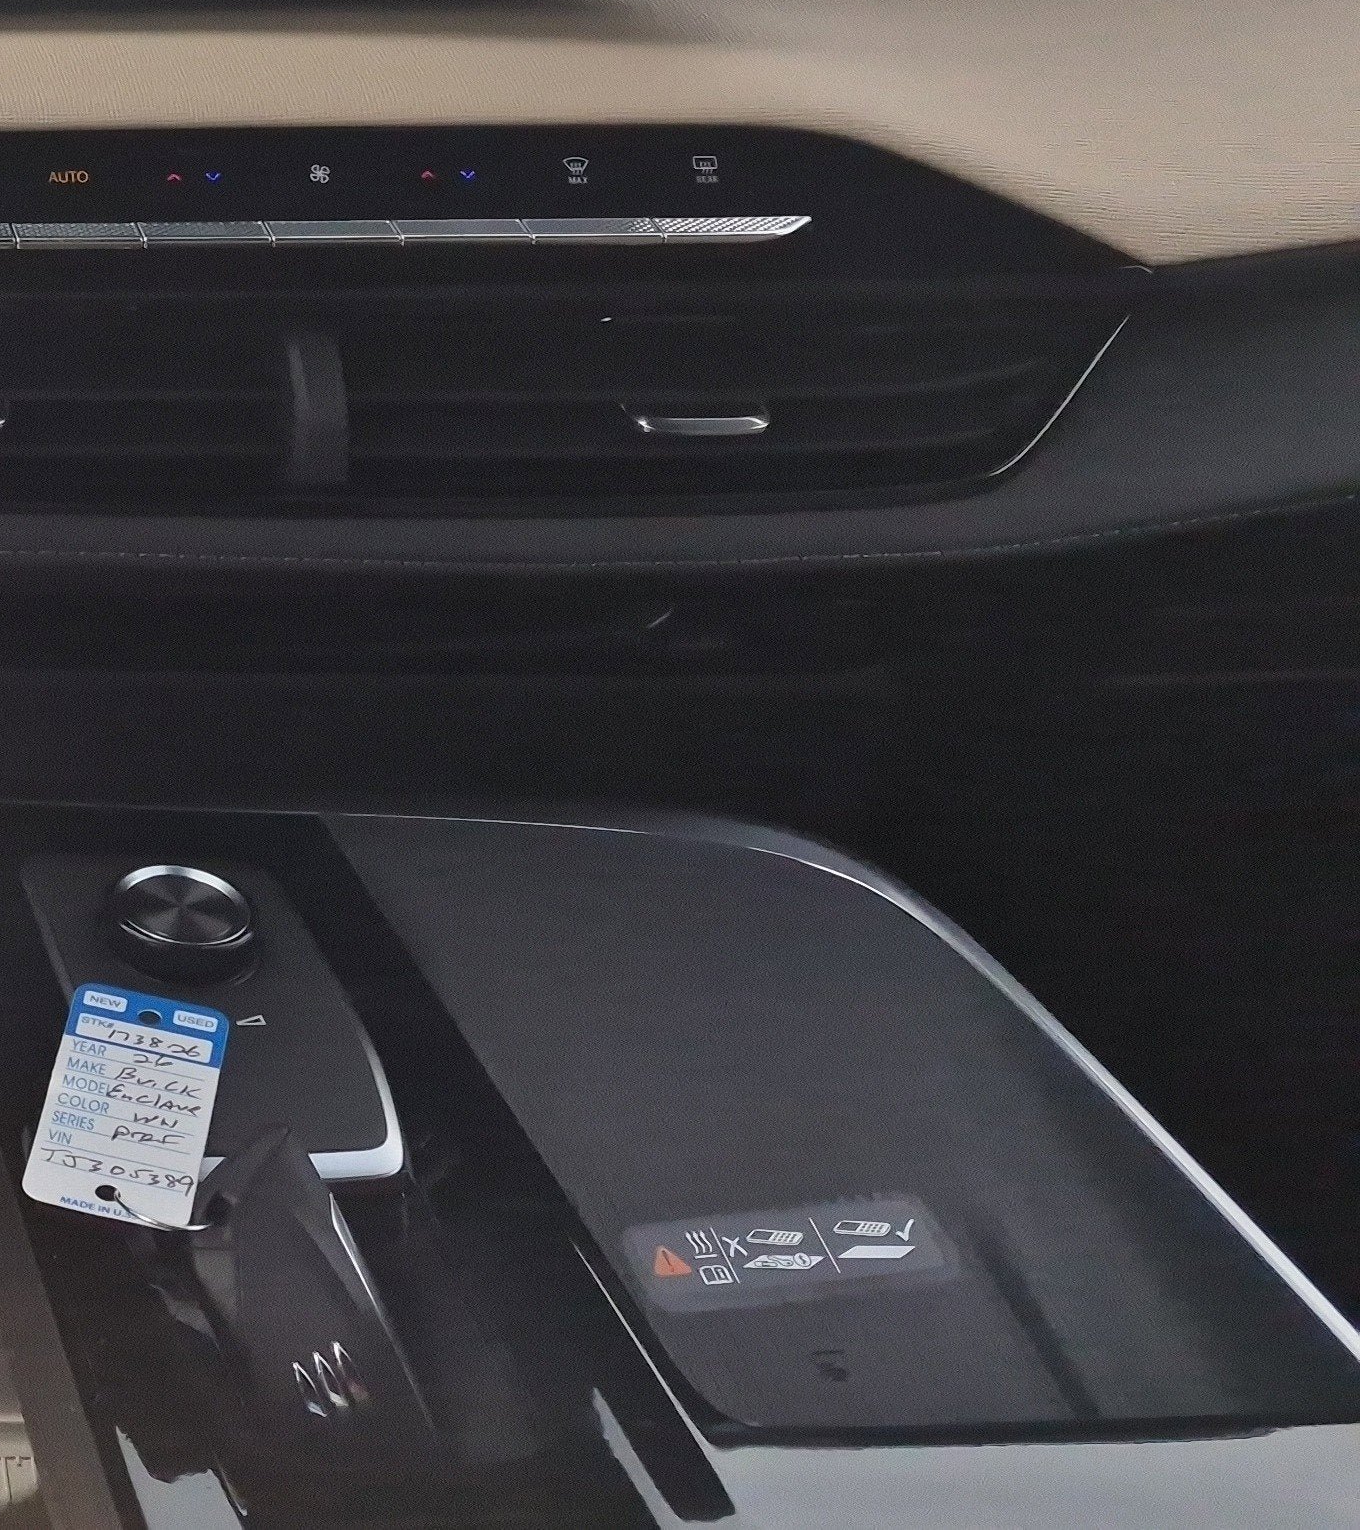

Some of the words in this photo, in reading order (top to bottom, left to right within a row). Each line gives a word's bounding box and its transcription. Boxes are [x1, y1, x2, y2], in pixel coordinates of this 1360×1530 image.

[48, 170, 89, 183] AUTO
[568, 176, 589, 185] MAX
[89, 994, 123, 1009] NEW
[81, 1016, 115, 1030] STK#
[177, 1013, 215, 1029] USED
[72, 1038, 107, 1058] YEAR
[66, 1055, 107, 1076] MAKE
[132, 1053, 174, 1068] 26
[57, 1092, 110, 1115] COLOR
[51, 1110, 95, 1131] SERIES
[48, 1128, 72, 1145] VIN
[60, 1195, 96, 1211] MADE
[97, 1205, 111, 1214] IN
